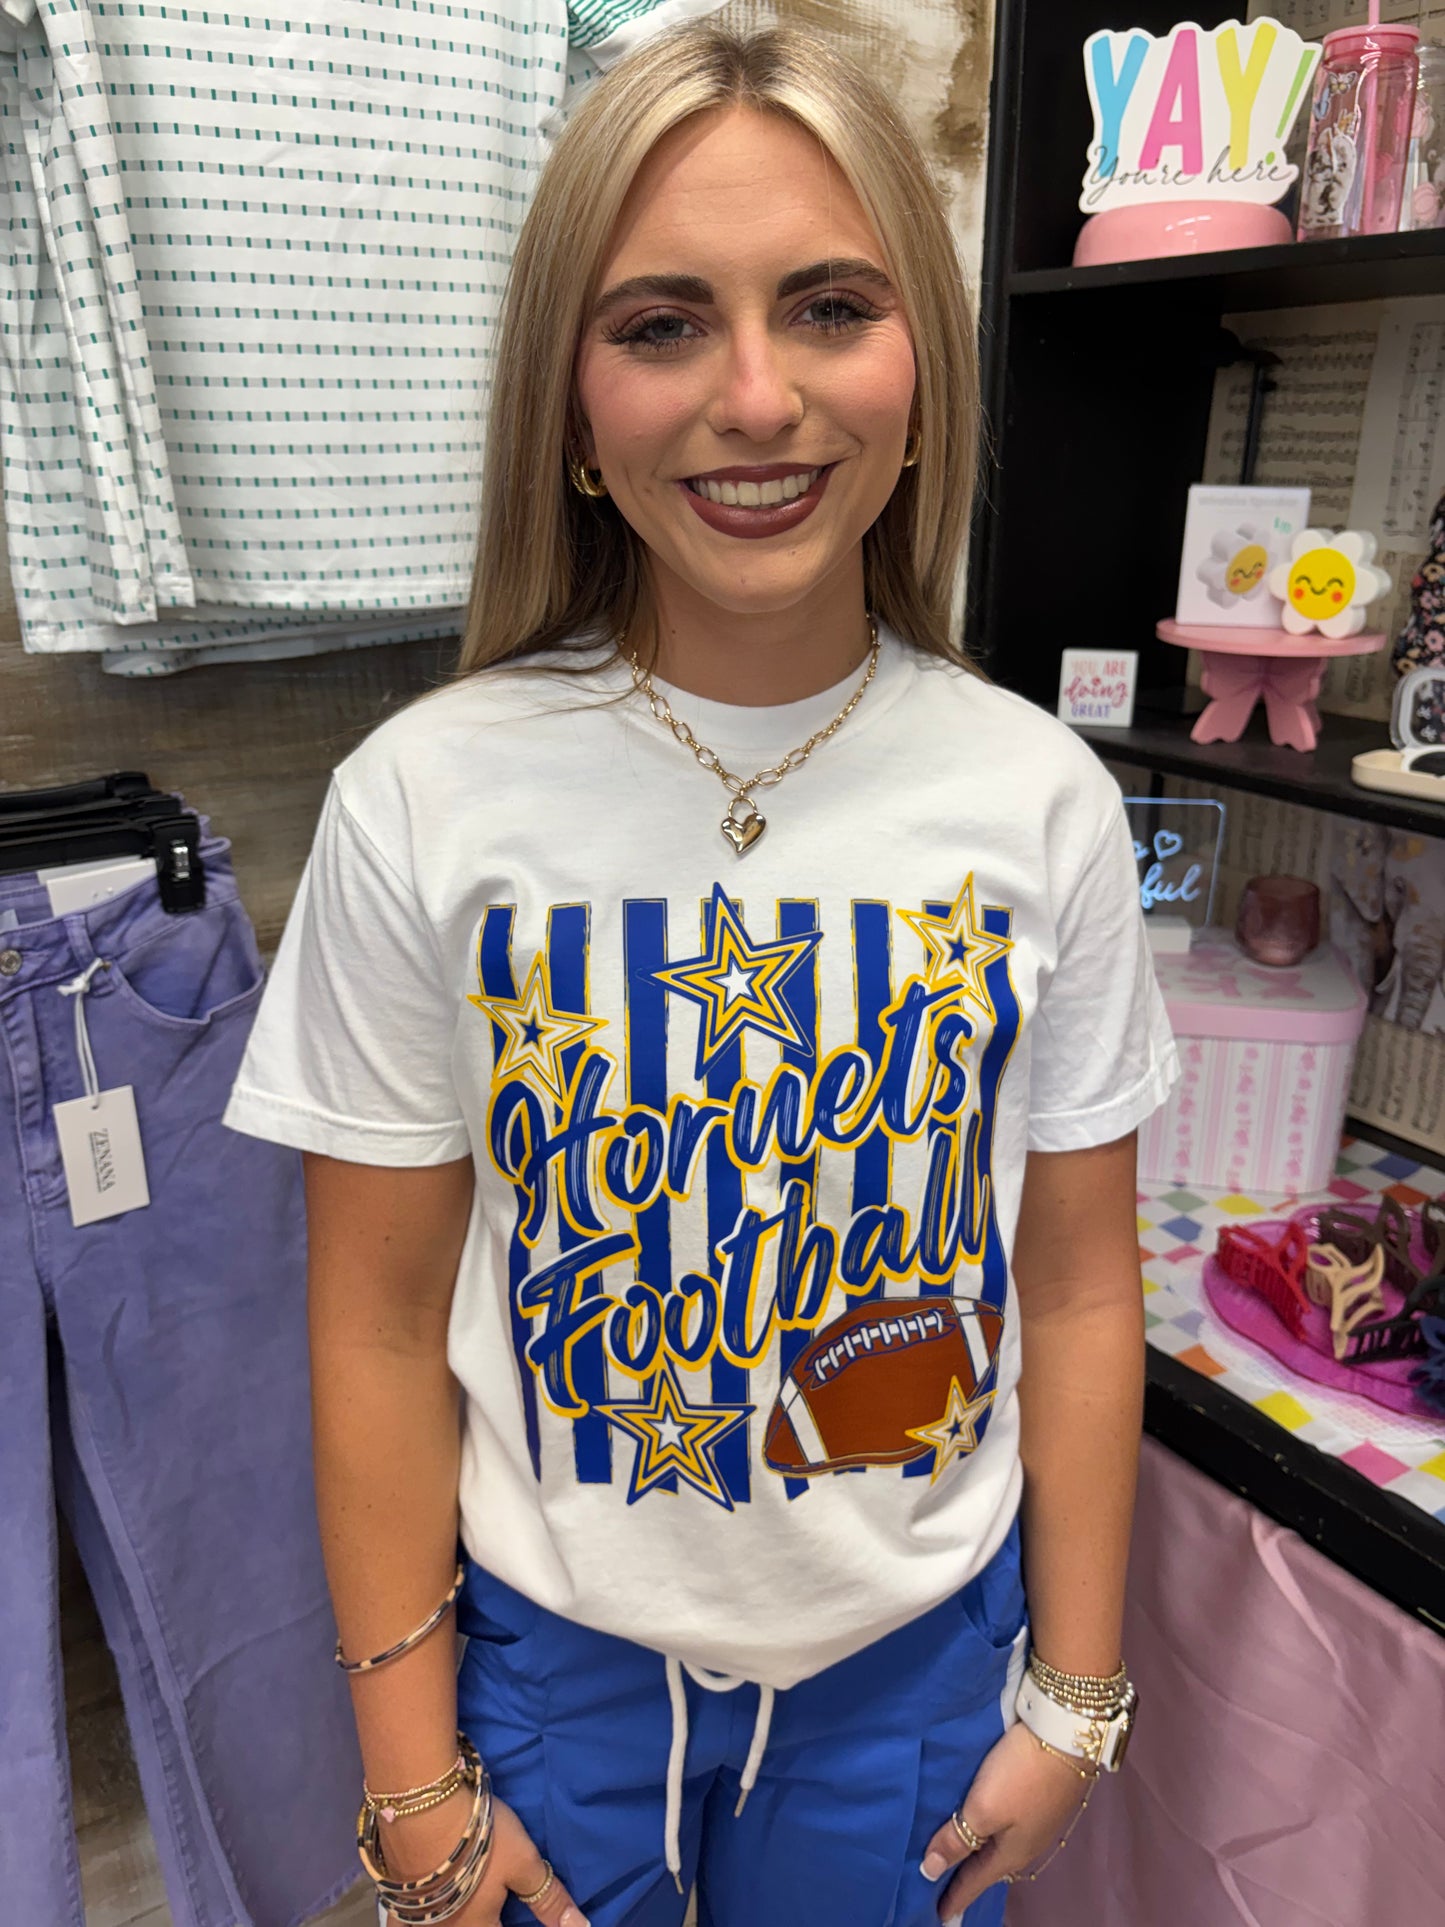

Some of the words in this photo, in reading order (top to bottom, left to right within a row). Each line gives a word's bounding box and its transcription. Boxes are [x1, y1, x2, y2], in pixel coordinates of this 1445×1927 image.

[1091, 22, 1316, 176] YAY!
[1086, 145, 1200, 206] You're
[1206, 144, 1291, 184] here
[1063, 675, 1128, 709] doing
[1103, 659, 1127, 677] ARE
[1071, 702, 1111, 719] GREAT
[487, 972, 979, 1247] Hornets
[93, 1127, 116, 1192] ZENANA
[518, 1111, 990, 1417] Football
